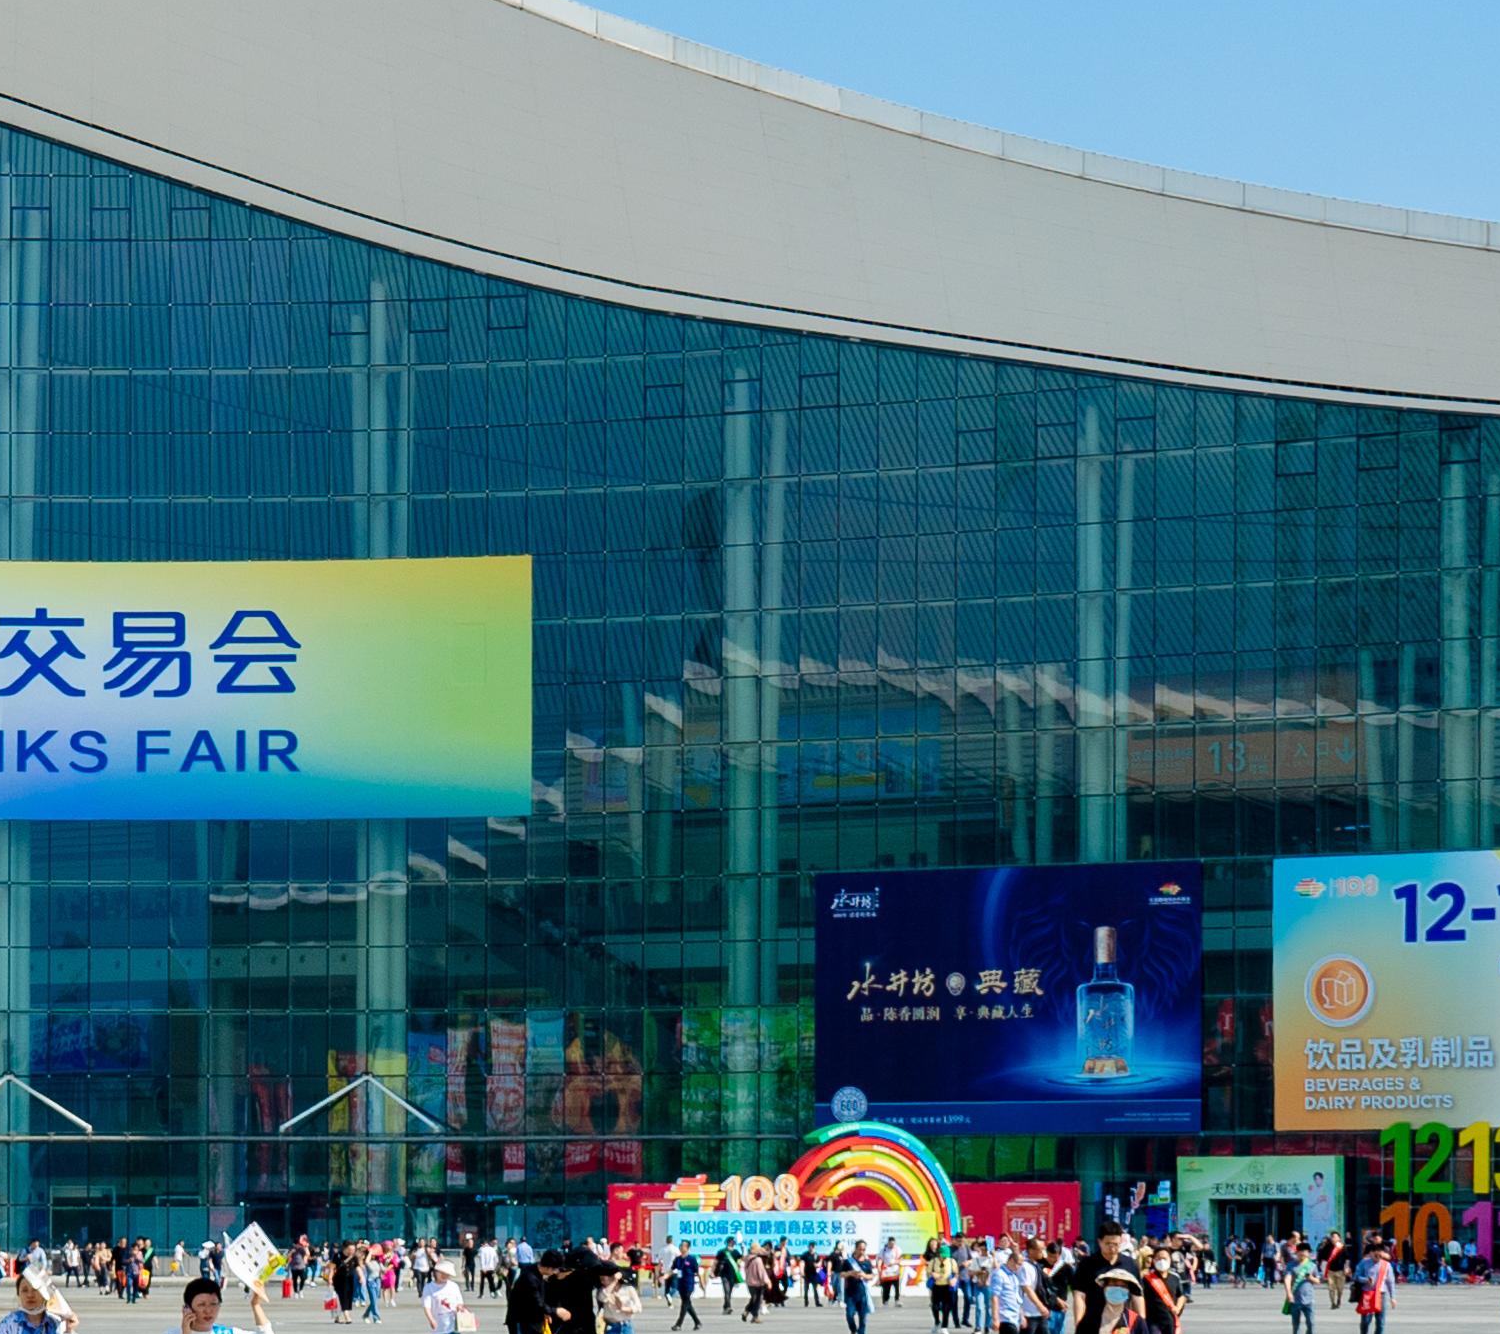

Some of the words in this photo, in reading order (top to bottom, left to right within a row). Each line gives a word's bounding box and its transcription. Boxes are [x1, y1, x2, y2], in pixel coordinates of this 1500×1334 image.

[137, 729, 302, 774] FAIR
[847, 962, 936, 1001] 水井坊
[1304, 1035, 1495, 1070] 饮品及乳制品
[1305, 1077, 1405, 1092] BEVERAGES
[1409, 1076, 1421, 1091] &
[1305, 1095, 1354, 1110] DAIRY
[1361, 1094, 1454, 1110] PRODUCTS
[720, 1173, 800, 1212] 108
